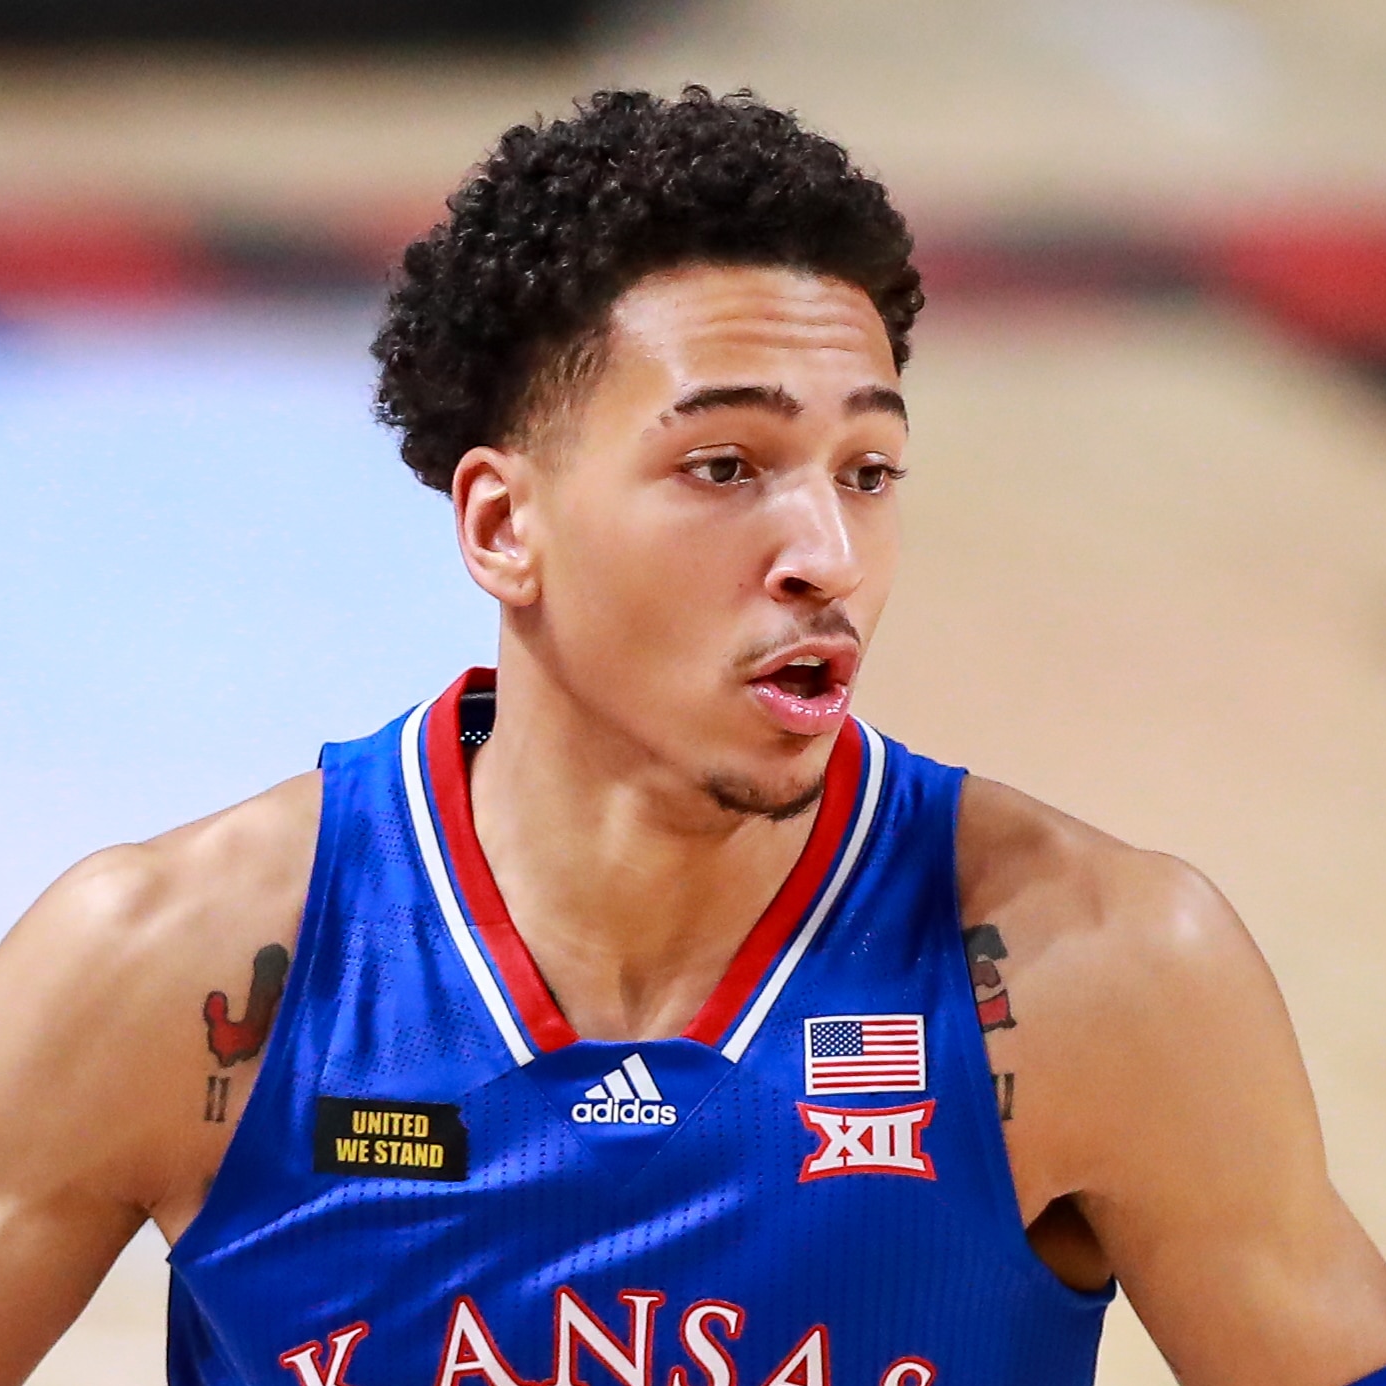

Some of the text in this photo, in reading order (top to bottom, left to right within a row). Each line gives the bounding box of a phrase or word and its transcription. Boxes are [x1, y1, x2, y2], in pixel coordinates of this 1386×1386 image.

[351, 1110, 430, 1138] UNITED
[571, 1097, 677, 1126] adidas
[335, 1137, 445, 1169] WE STAND
[806, 1108, 927, 1174] XII
